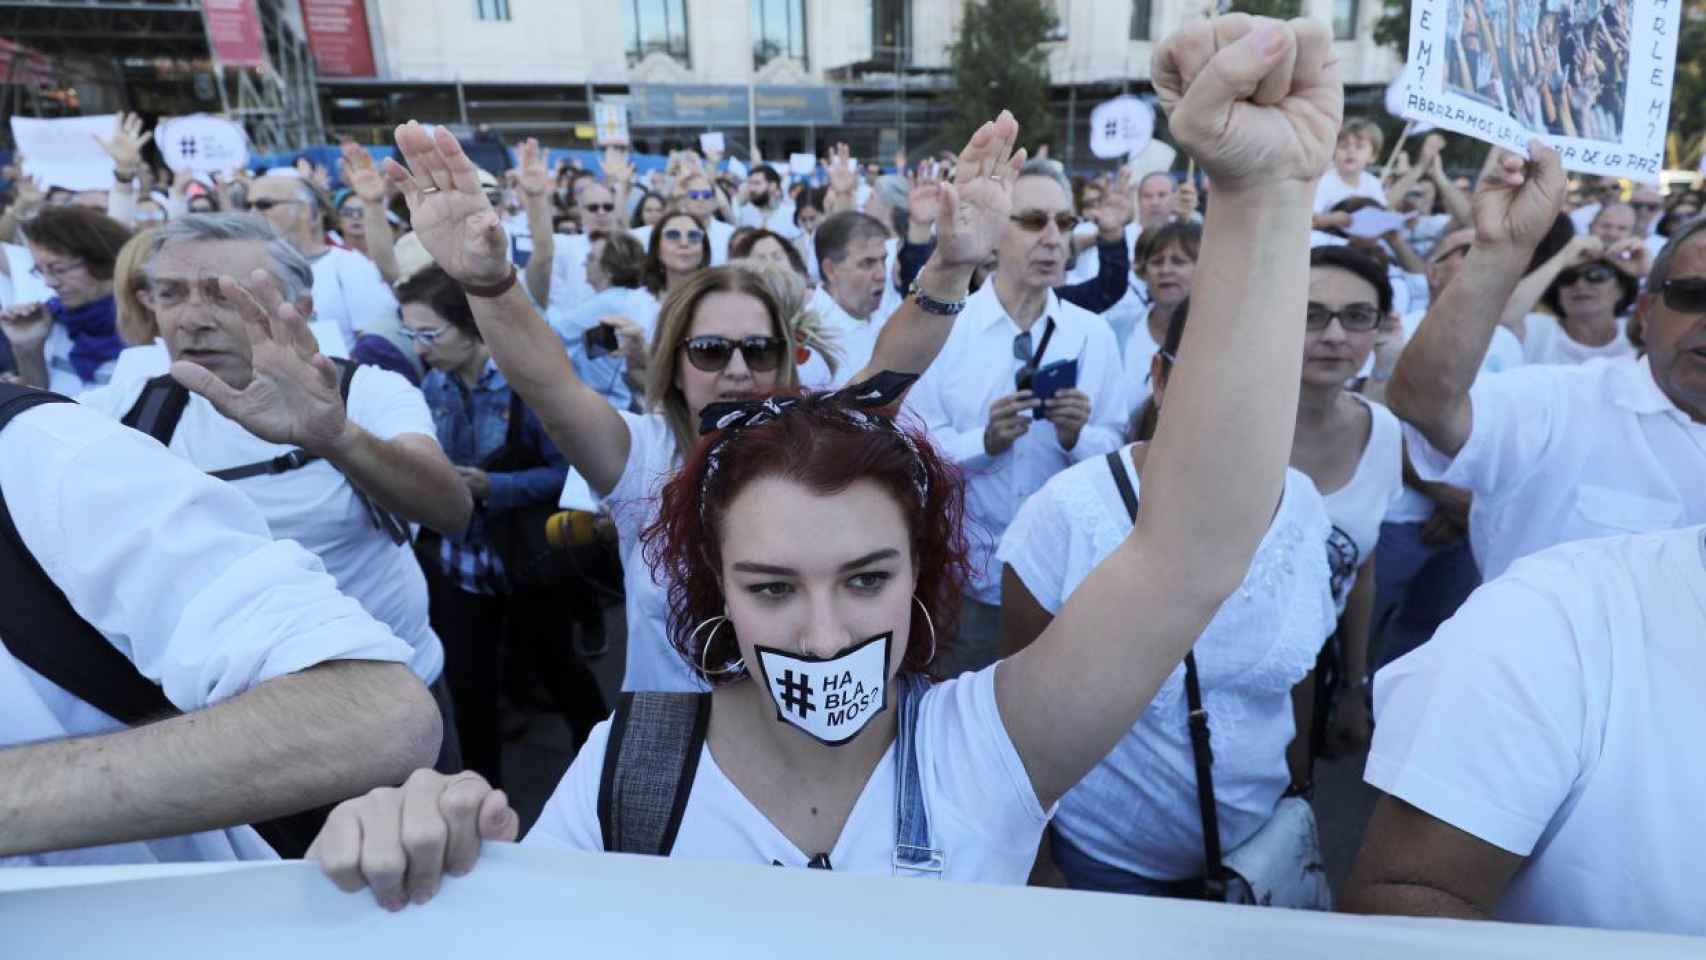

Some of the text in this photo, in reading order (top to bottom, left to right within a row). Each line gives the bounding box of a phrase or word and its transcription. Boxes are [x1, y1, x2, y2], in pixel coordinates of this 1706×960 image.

[1416, 0, 1434, 90] EM?
[1582, 149, 1600, 165] DE
[1604, 153, 1623, 167] LA
[776, 669, 817, 720] #
[823, 671, 852, 692] HA
[825, 681, 864, 709] BLA
[827, 687, 879, 727] MOS?
